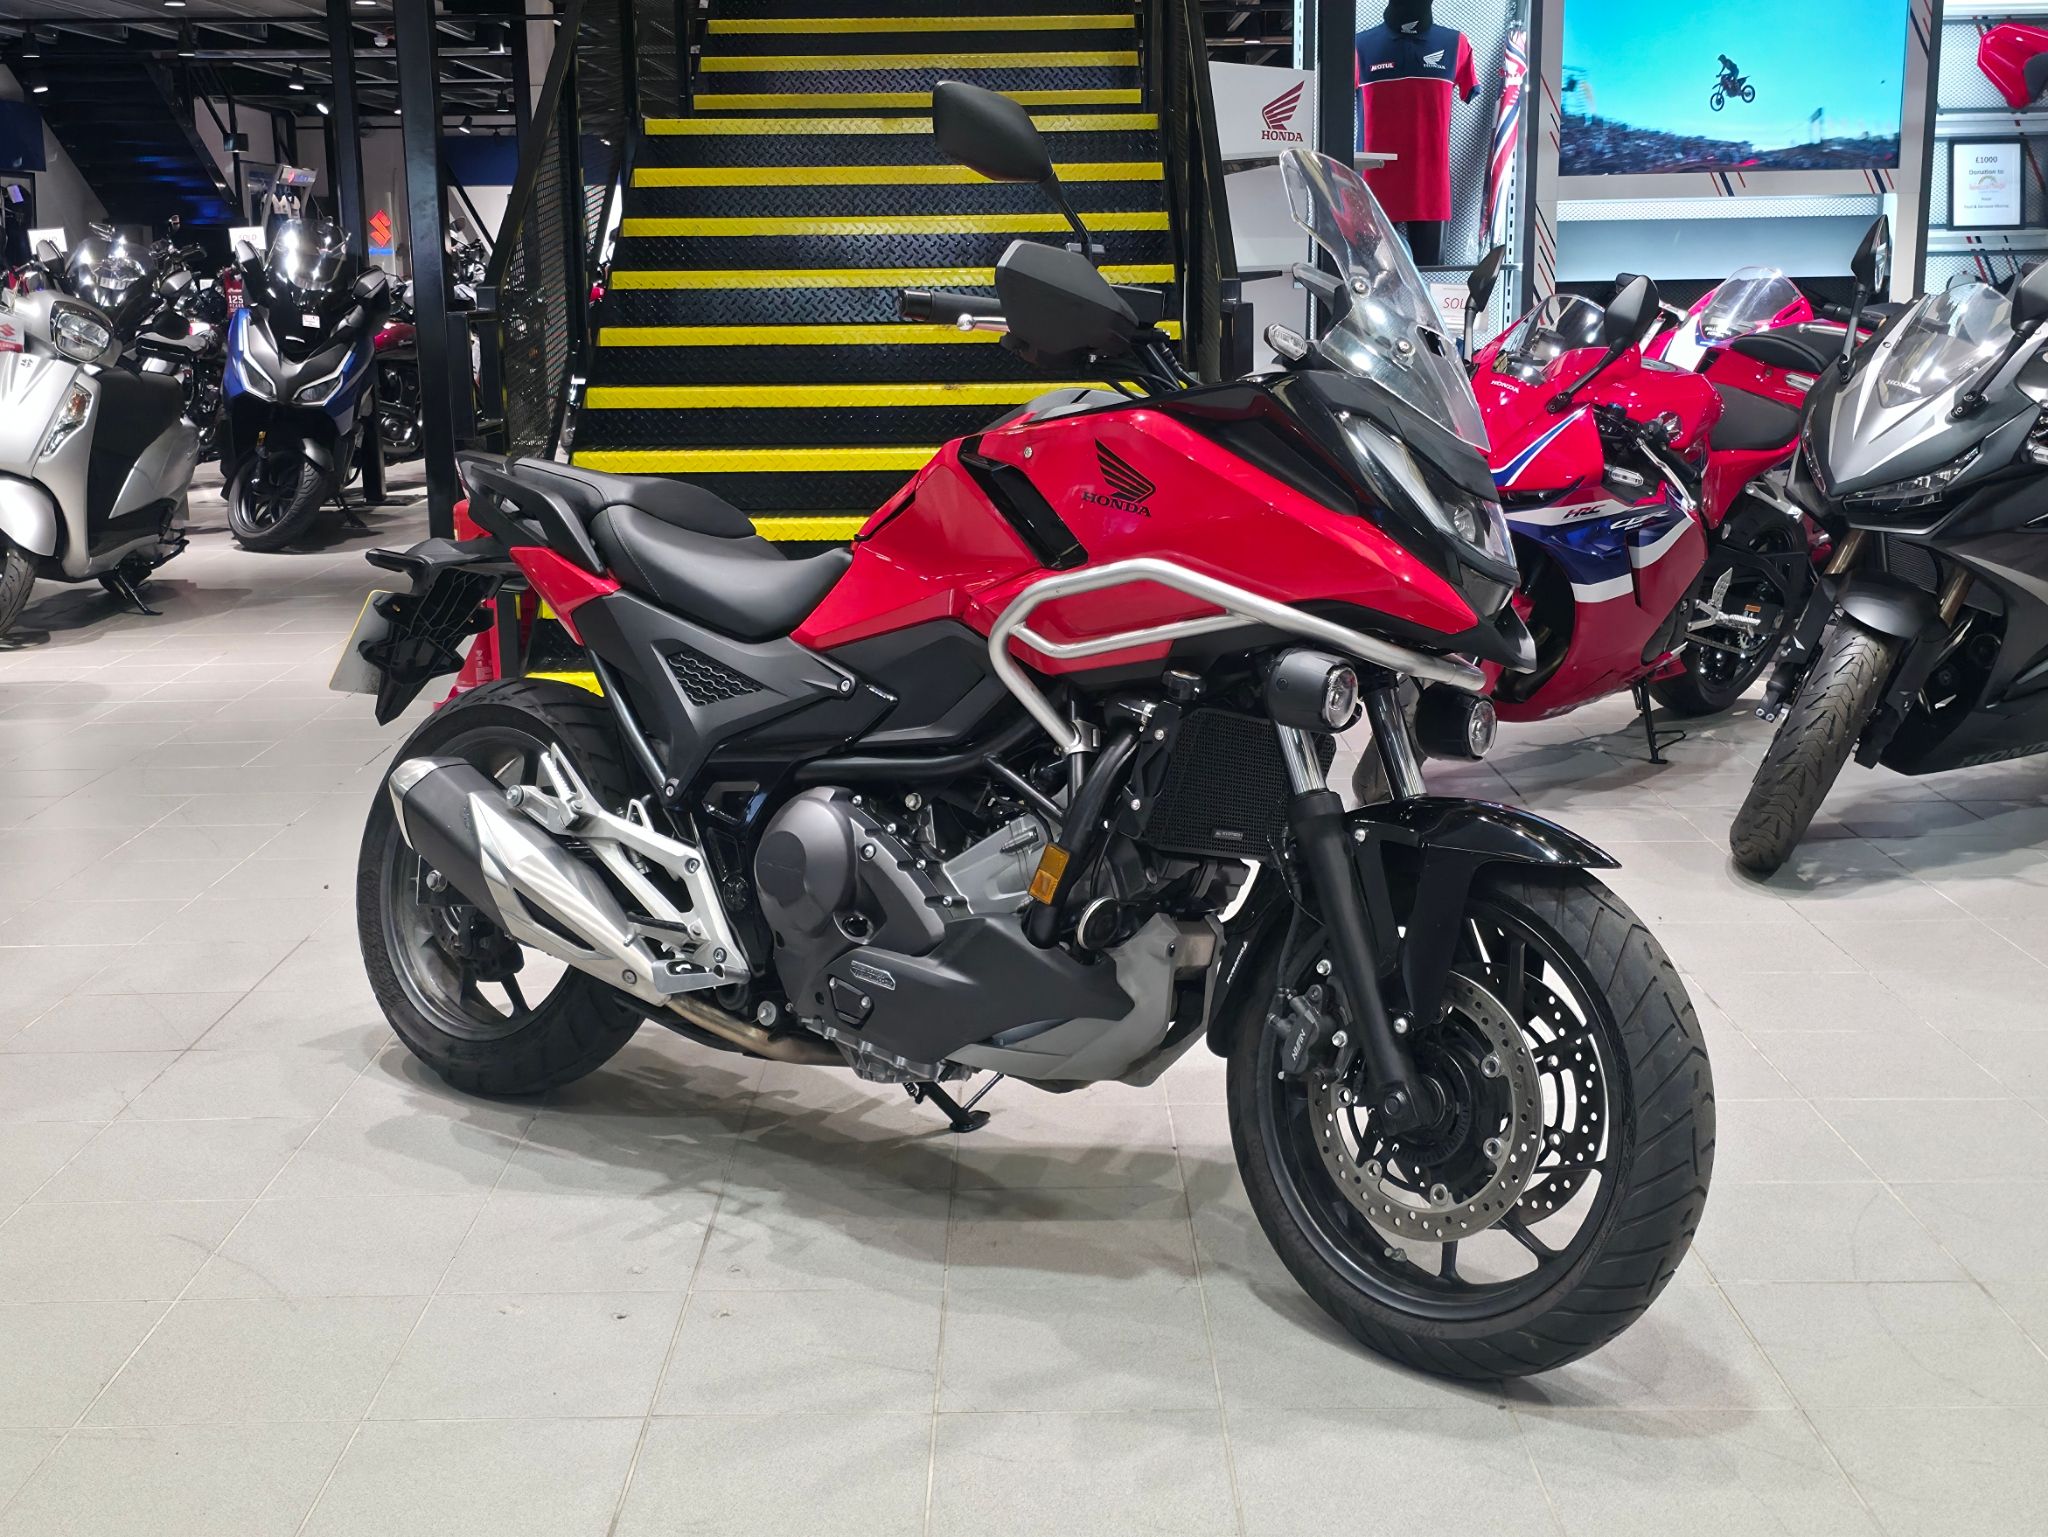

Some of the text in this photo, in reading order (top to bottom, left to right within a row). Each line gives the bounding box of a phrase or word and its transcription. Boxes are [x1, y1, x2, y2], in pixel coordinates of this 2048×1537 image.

[1370, 63, 1394, 71] MOTUL
[1261, 130, 1303, 142] HONDA
[1975, 156, 1998, 164] £1000
[228, 295, 244, 304] 125
[1443, 297, 1466, 310] SOL
[1490, 380, 1520, 394] HONDA
[1081, 491, 1152, 518] HONDA
[1562, 504, 1606, 519] HRC
